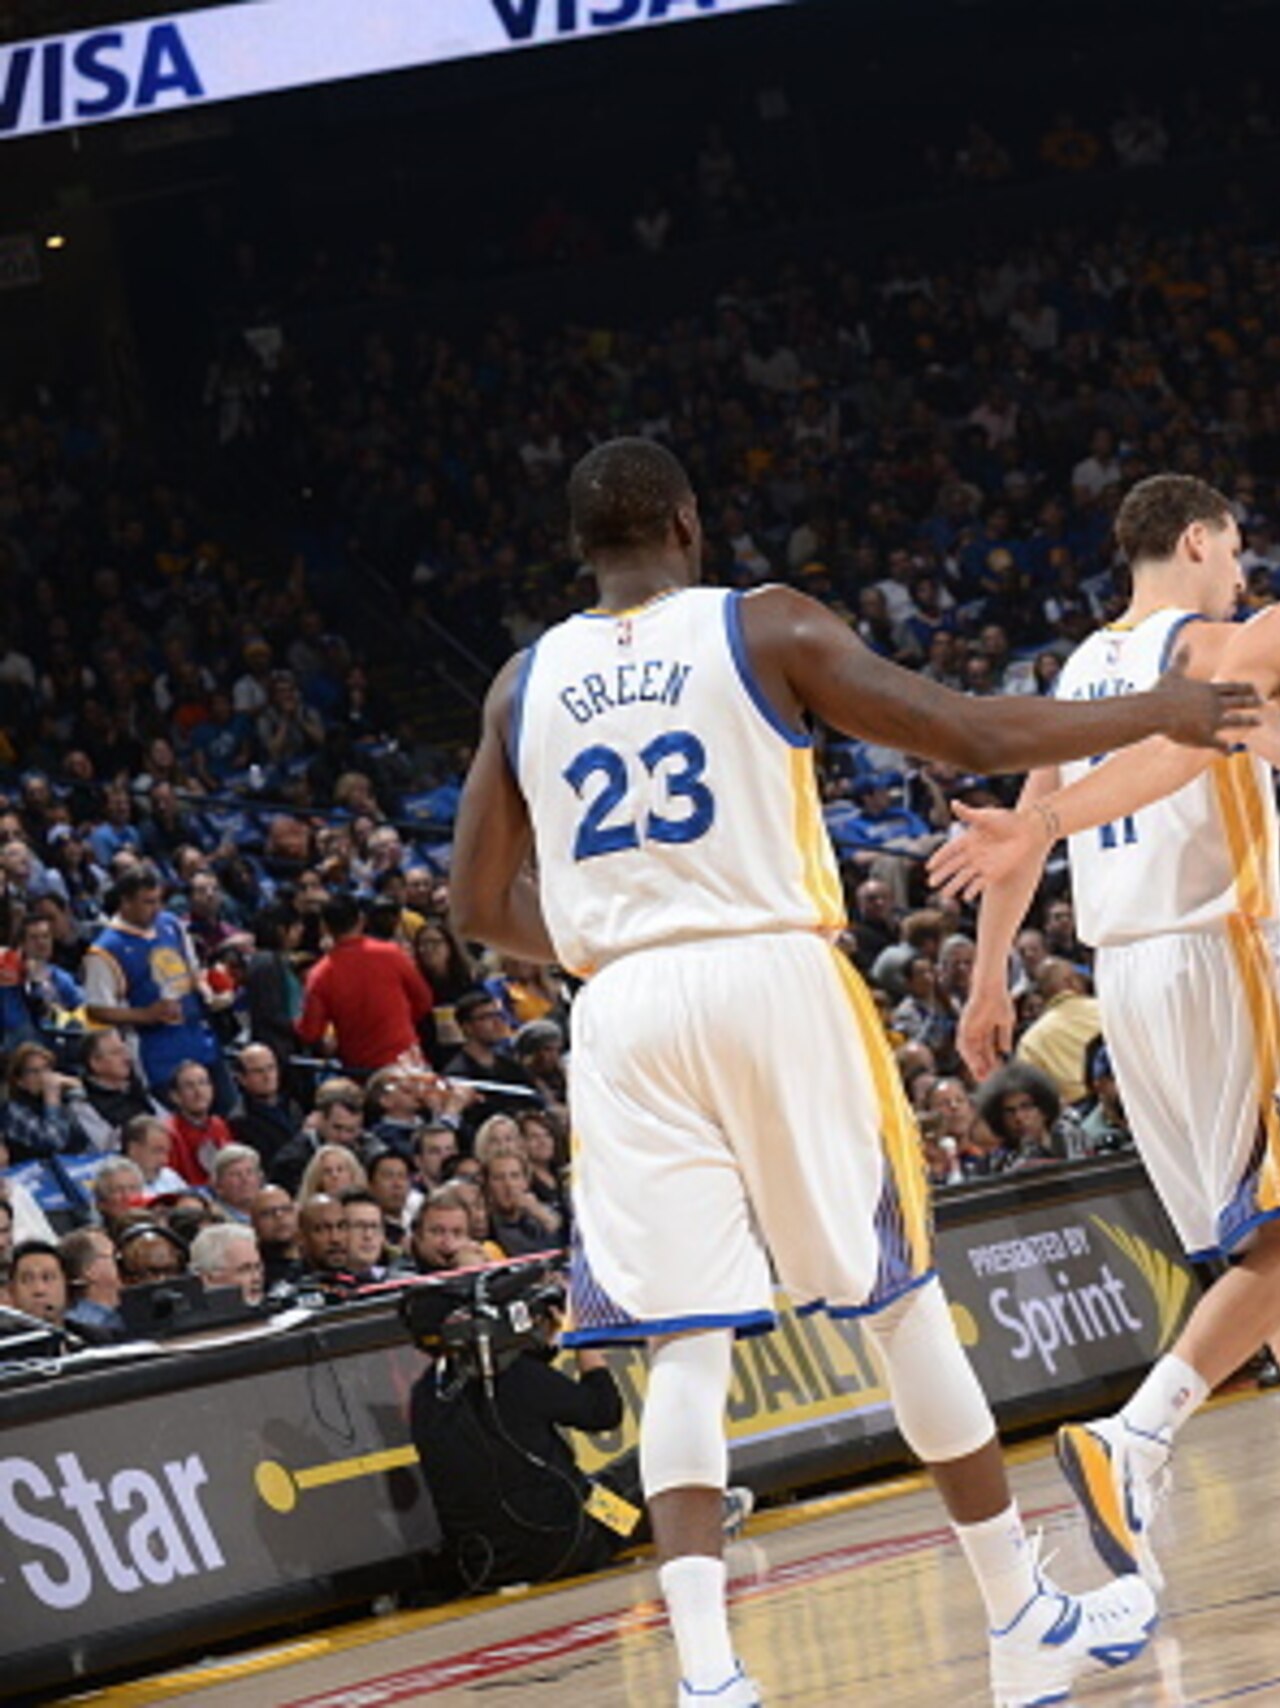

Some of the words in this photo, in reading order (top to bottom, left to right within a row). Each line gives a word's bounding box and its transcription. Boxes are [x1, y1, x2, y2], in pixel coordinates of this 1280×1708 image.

[0, 23, 205, 130] VISA
[560, 660, 692, 724] GREEN
[562, 730, 716, 863] 23
[967, 1231, 1068, 1277] PRESENTED
[1062, 1227, 1091, 1256] BY
[989, 1264, 1143, 1375] Sprint
[0, 1452, 226, 1609] Star
